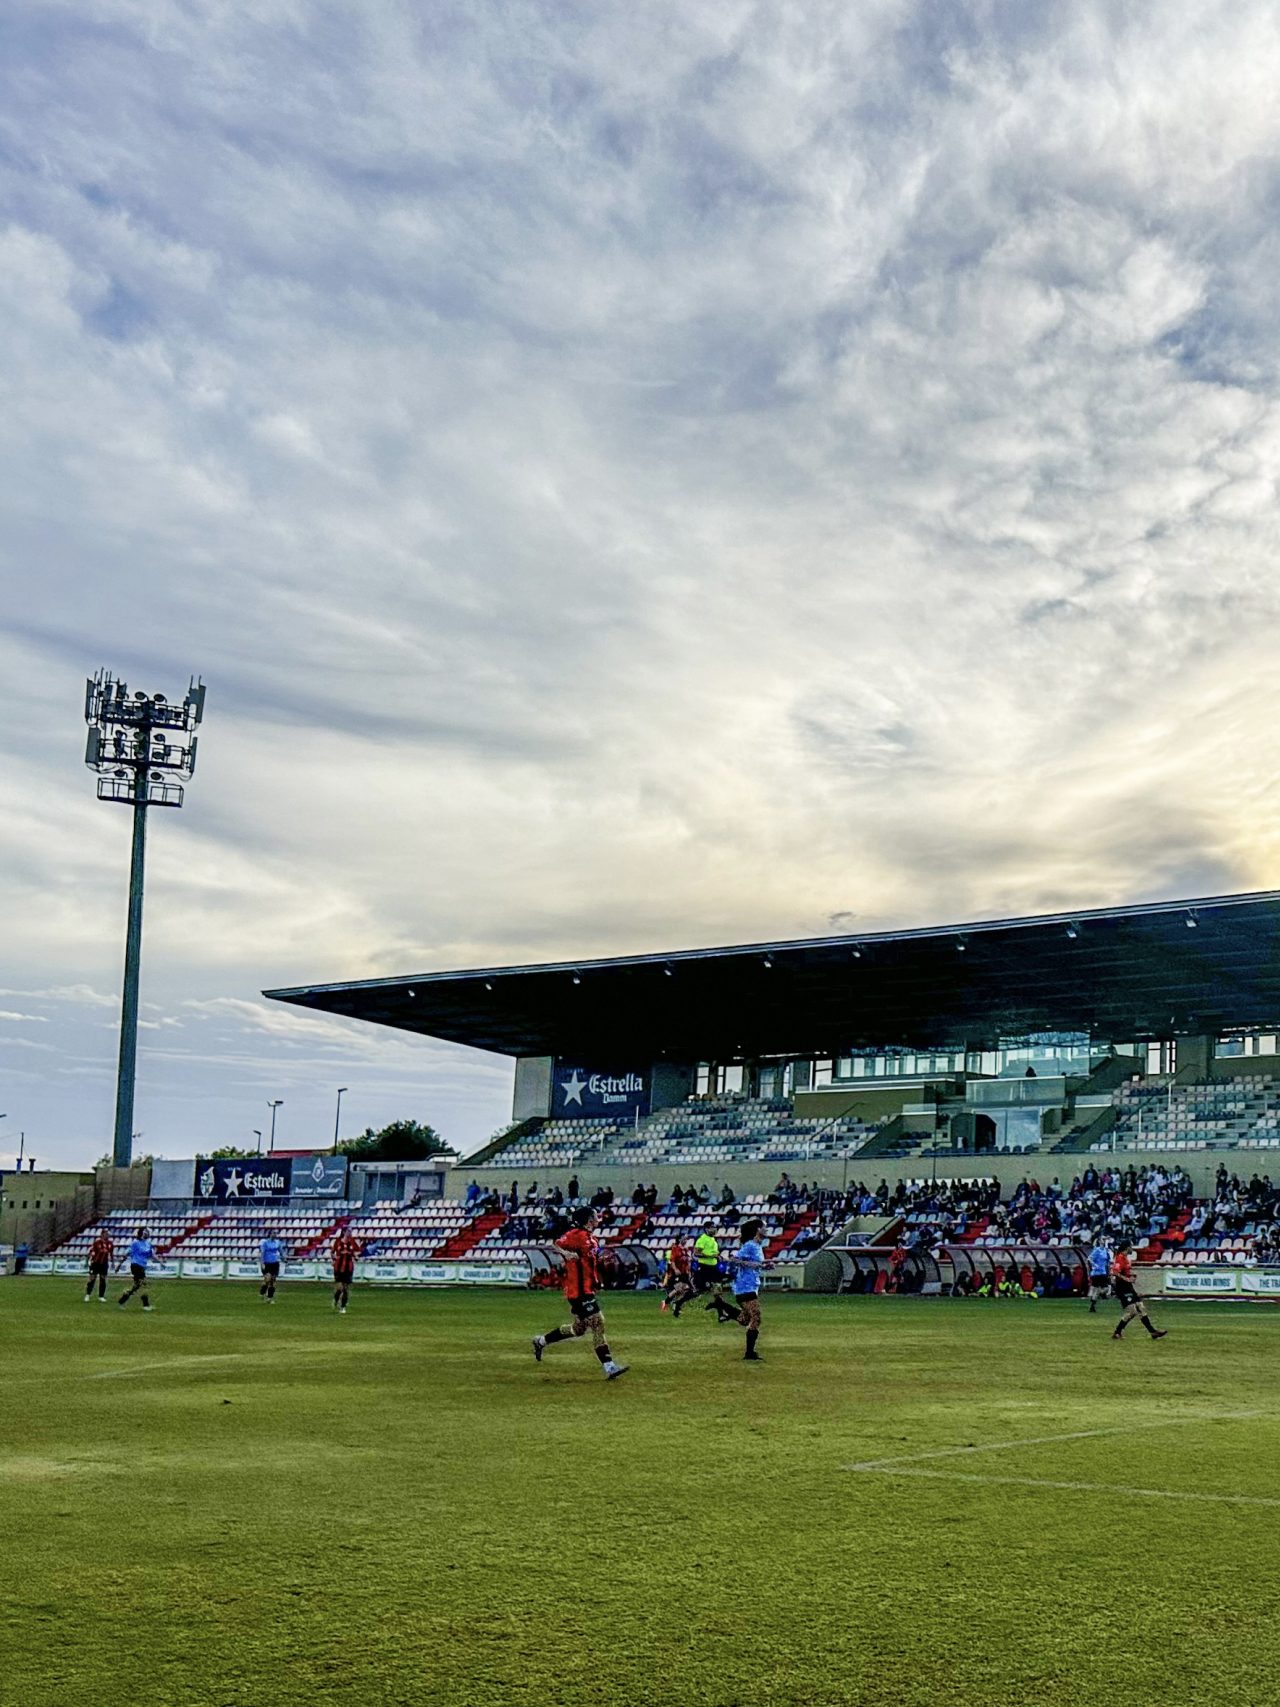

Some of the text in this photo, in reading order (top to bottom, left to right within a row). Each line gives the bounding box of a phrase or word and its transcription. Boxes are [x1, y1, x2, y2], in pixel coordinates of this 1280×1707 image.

[588, 1073, 643, 1095] Estrella
[602, 1093, 627, 1104] Damm
[243, 1172, 285, 1190] Estrella
[1200, 1278, 1211, 1287] AND
[1259, 1279, 1269, 1288] THE
